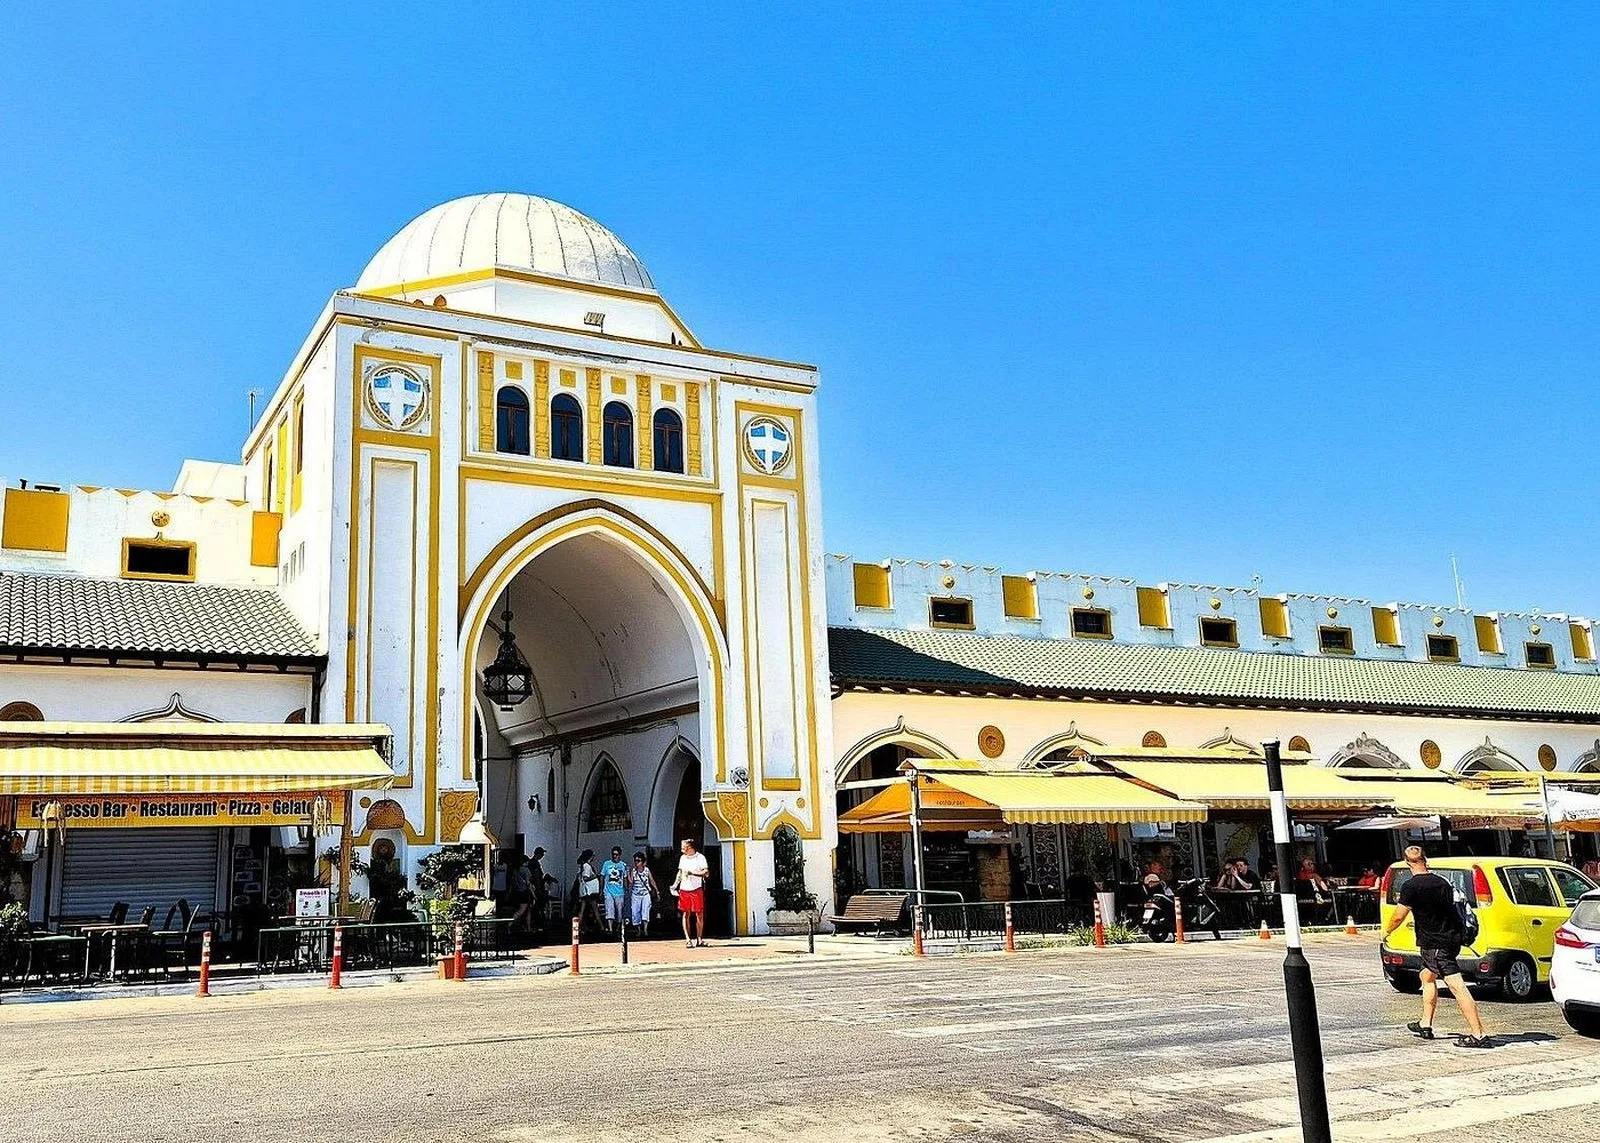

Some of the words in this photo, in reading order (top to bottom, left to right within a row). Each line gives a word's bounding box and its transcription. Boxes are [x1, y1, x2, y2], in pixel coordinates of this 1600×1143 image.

[102, 800, 128, 817] Bar
[140, 800, 218, 817] Restaurant
[228, 799, 262, 816] Pizza
